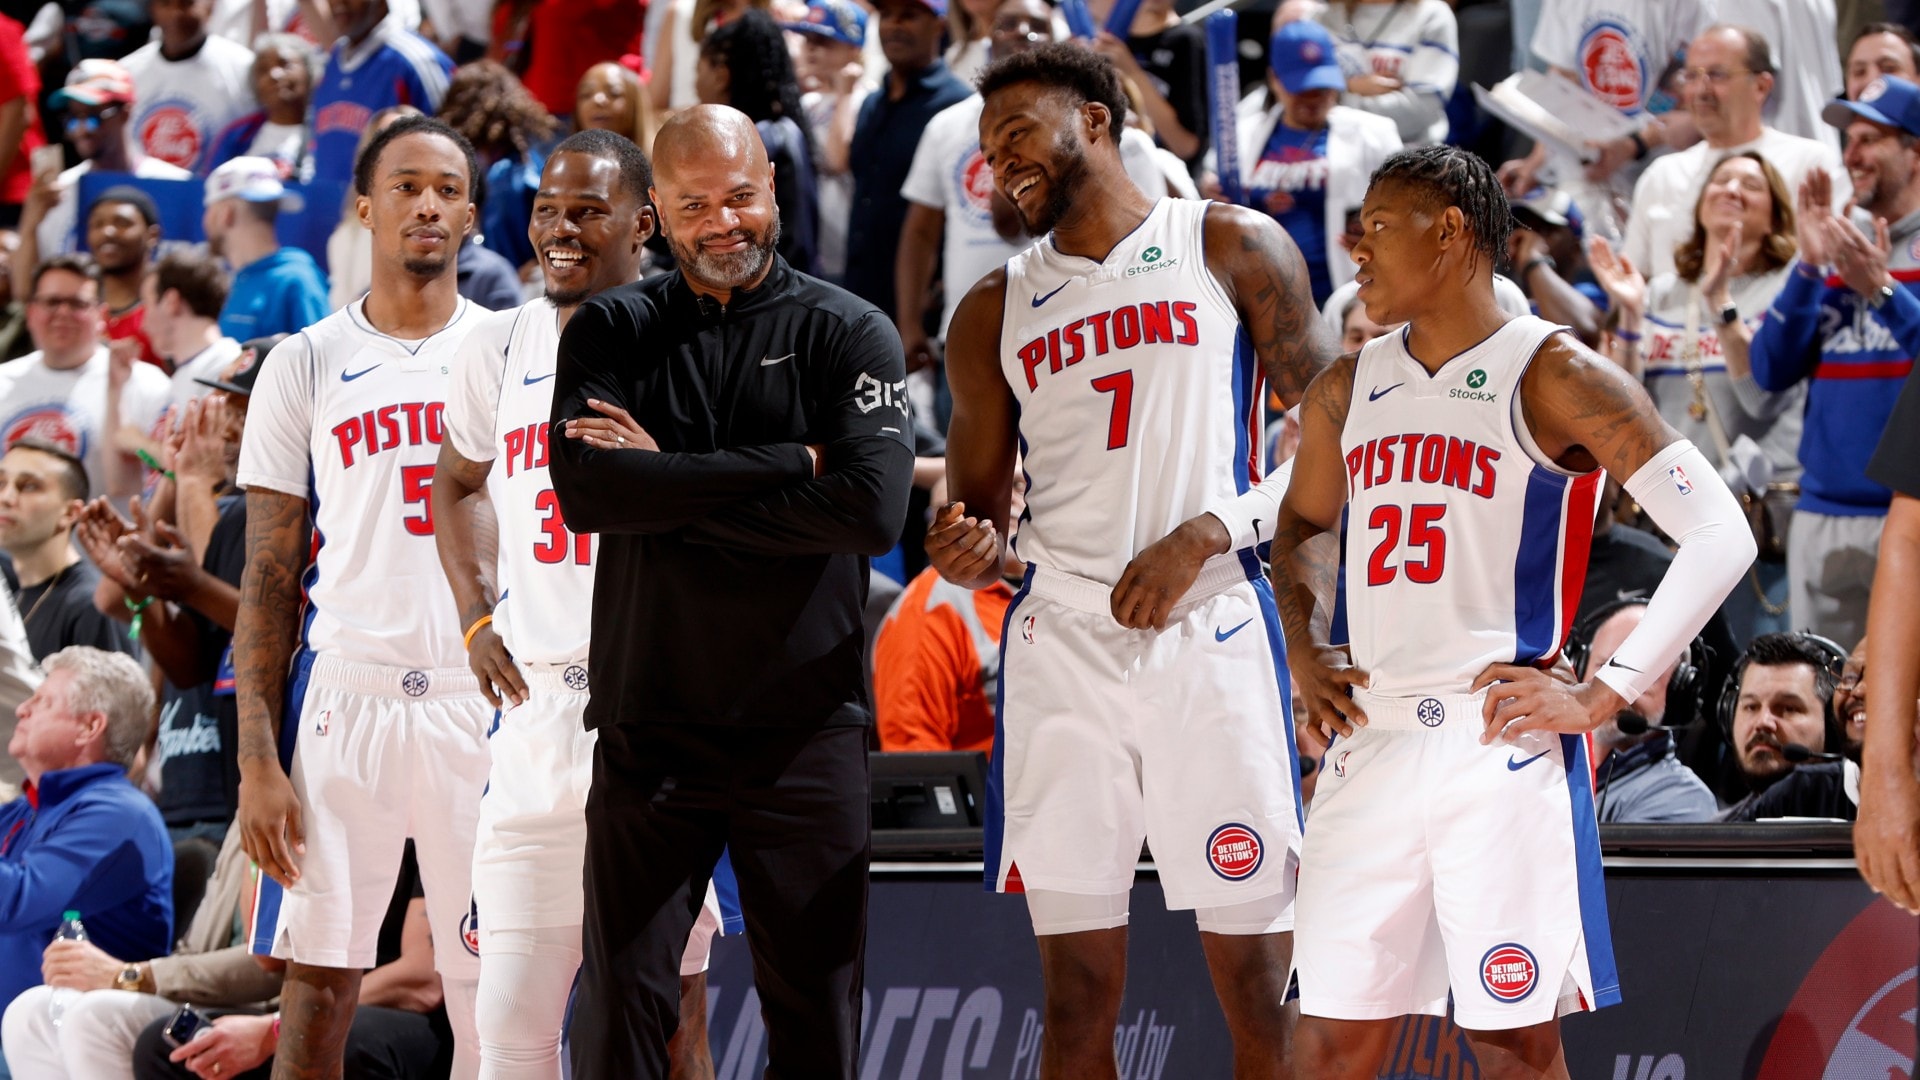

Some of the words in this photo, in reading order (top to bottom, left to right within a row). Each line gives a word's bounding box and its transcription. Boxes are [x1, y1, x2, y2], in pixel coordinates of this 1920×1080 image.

[1127, 258, 1177, 276] StockX
[1017, 301, 1199, 394] PISTONS
[1090, 369, 1134, 451] 7
[1449, 388, 1497, 403] StockX
[331, 402, 446, 470] PISTO
[1345, 433, 1502, 502] PISTONS
[400, 464, 437, 536] 5
[1367, 503, 1448, 587] 25
[1216, 840, 1251, 854] DETROIT
[1218, 849, 1254, 864] PISTONS
[1490, 961, 1527, 974] DETROIT
[1490, 971, 1528, 984] PISTONS
